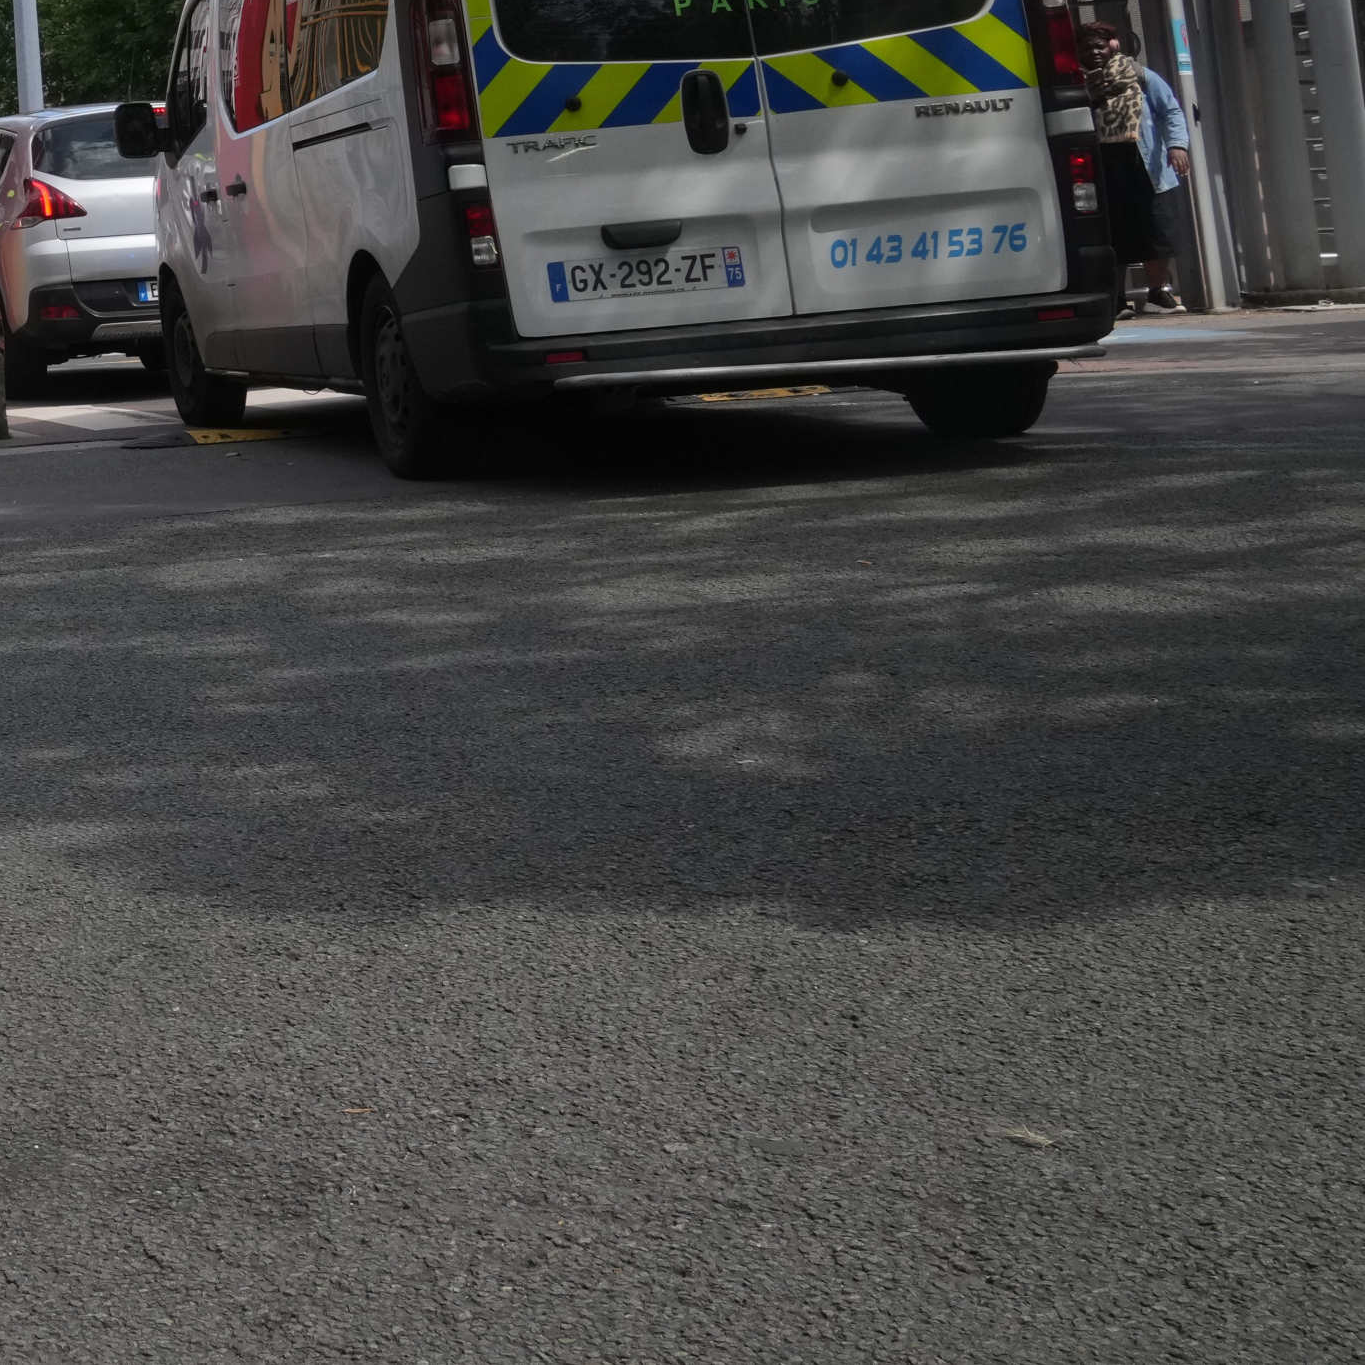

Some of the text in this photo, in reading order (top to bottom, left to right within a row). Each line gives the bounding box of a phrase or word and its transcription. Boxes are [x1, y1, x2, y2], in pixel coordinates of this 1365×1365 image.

[914, 98, 1014, 118] RENAULT
[506, 135, 599, 154] TRAFIC
[830, 222, 1028, 269] 01 43 41 53 76
[571, 252, 717, 292] GX-292-ZF
[727, 267, 743, 281] 75
